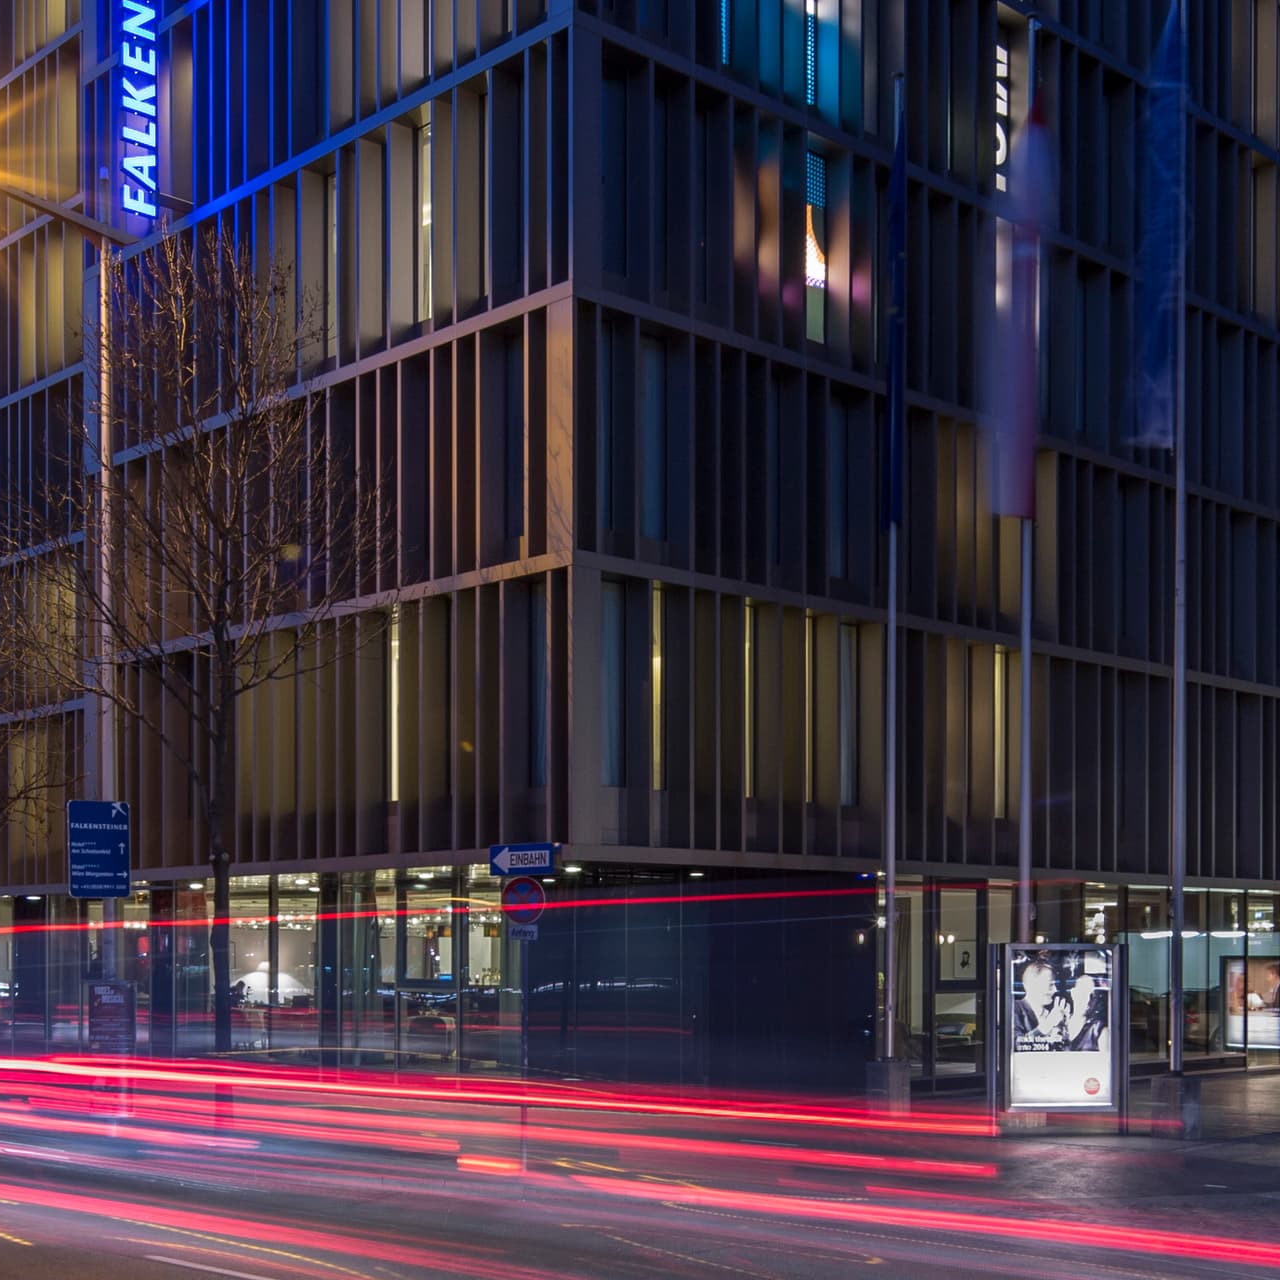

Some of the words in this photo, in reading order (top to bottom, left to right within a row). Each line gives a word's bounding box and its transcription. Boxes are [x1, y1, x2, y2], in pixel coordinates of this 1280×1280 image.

[70, 822, 128, 831] FALKENSTEINER
[509, 851, 546, 866] EINBAHN
[511, 927, 536, 938] Anfang
